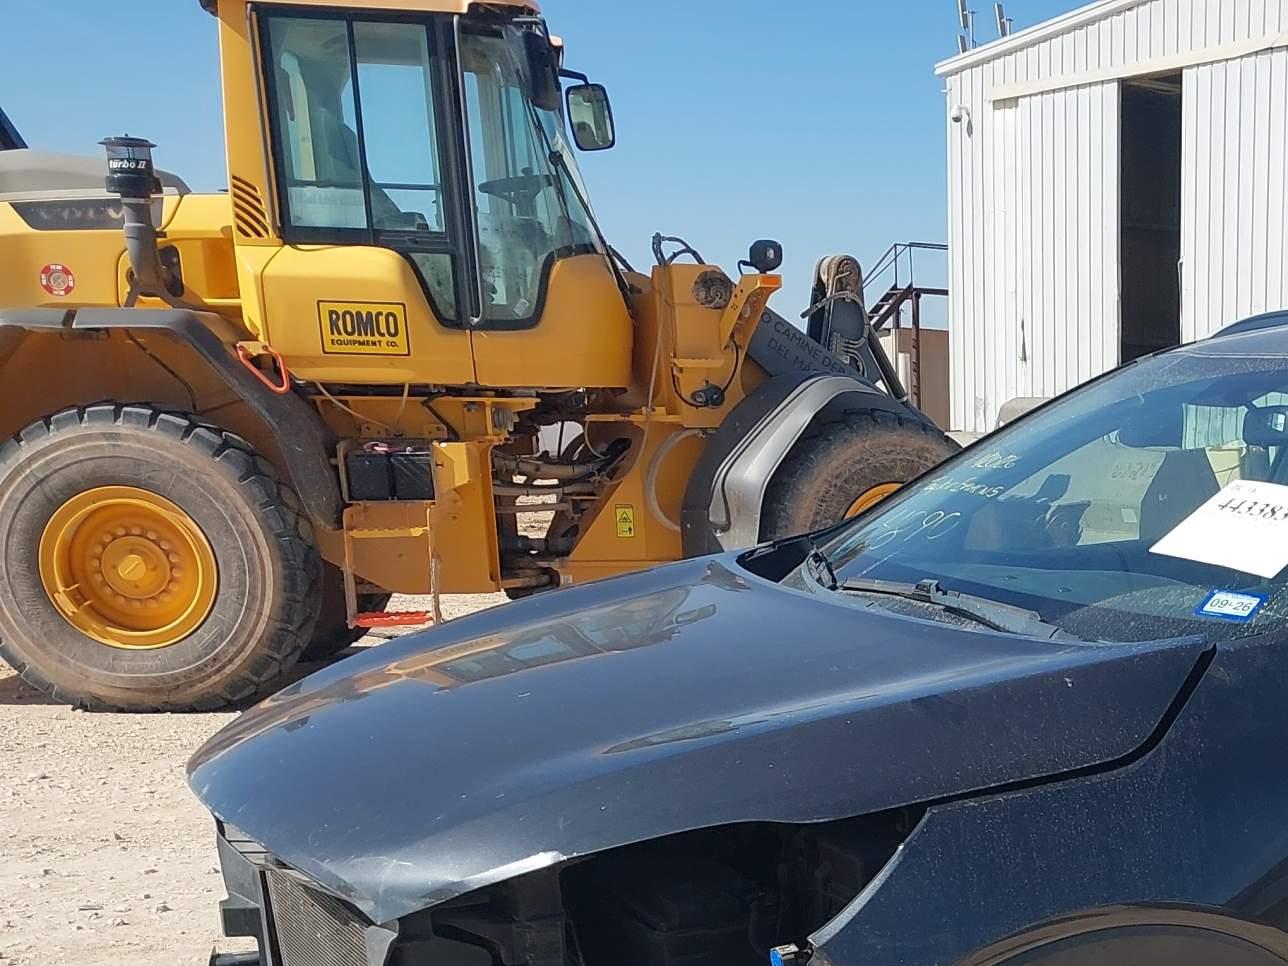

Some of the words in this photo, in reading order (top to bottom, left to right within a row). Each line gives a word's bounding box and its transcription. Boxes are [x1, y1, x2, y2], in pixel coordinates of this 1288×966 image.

[327, 309, 399, 338] ROMCO
[330, 339, 382, 347] EQUIPMENT
[386, 340, 400, 348] CO.
[767, 337, 791, 360] DEL
[774, 321, 823, 360] CAMINE
